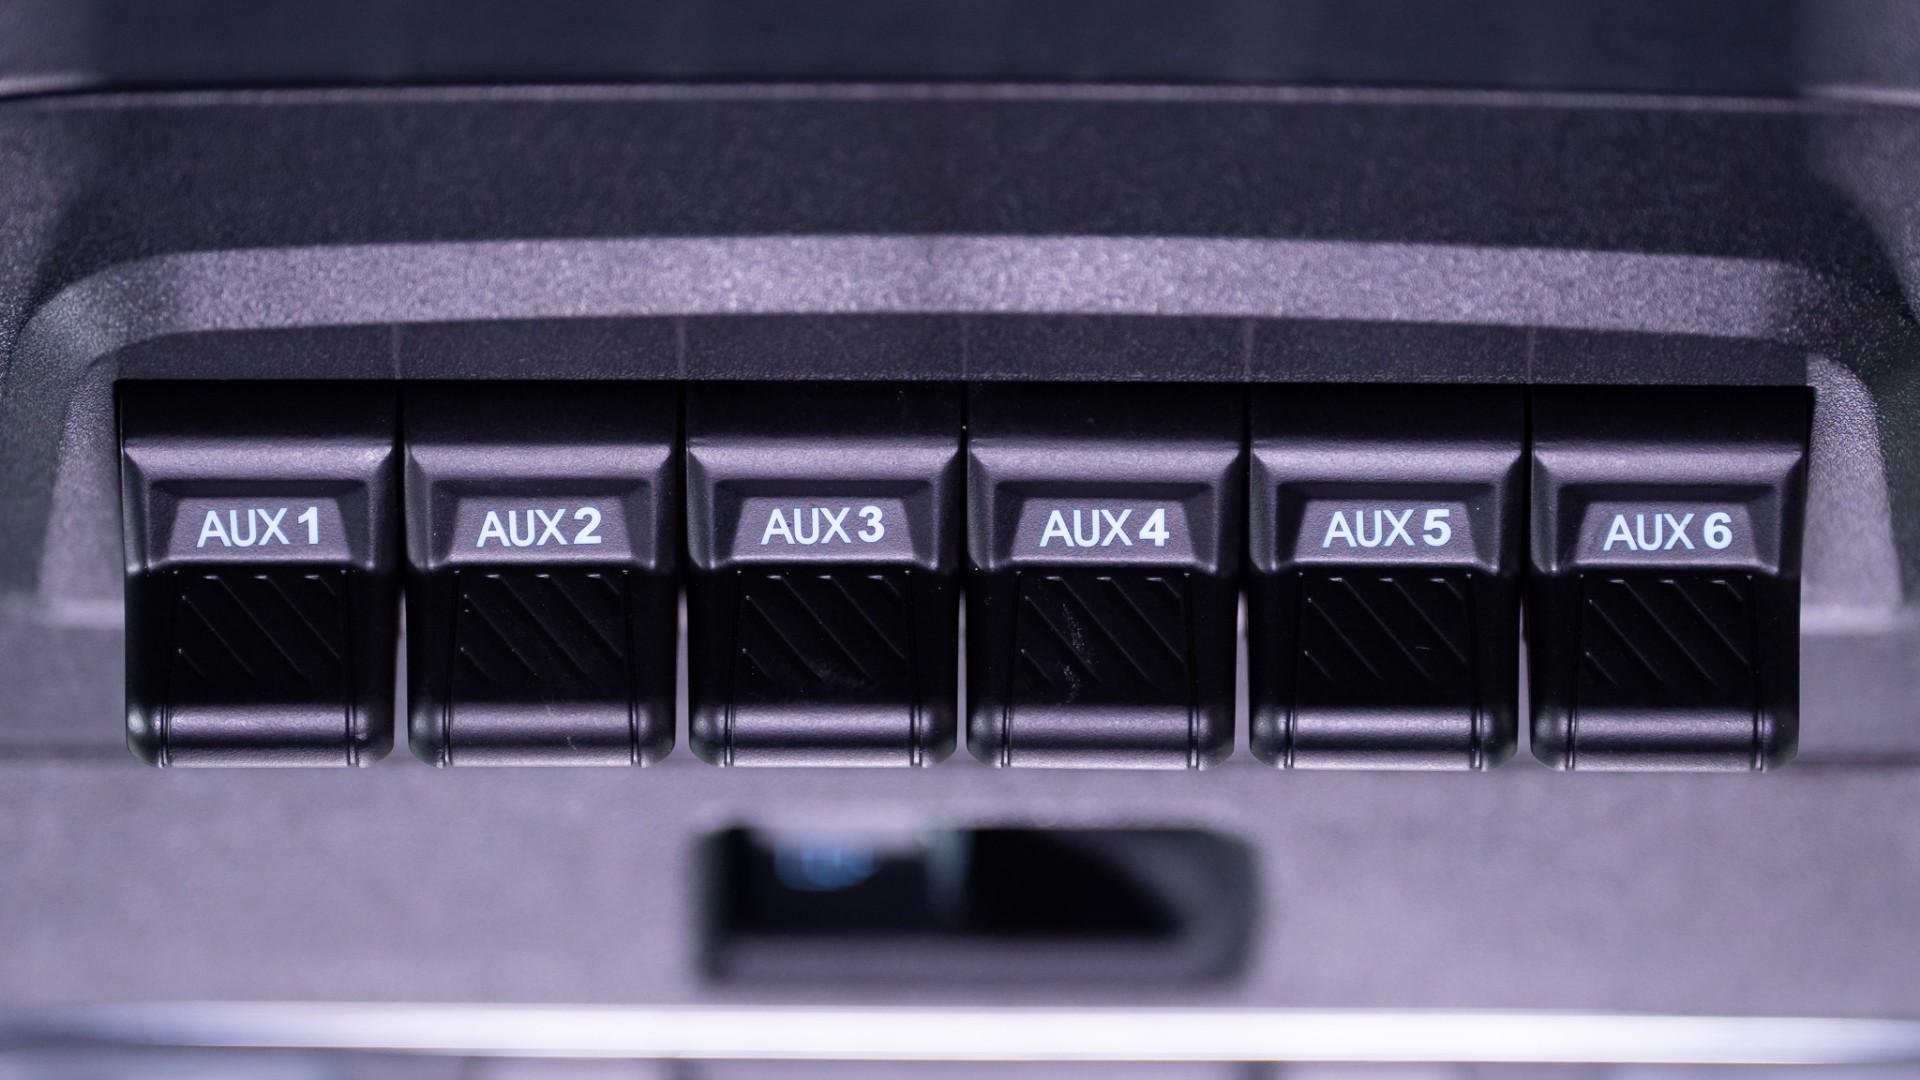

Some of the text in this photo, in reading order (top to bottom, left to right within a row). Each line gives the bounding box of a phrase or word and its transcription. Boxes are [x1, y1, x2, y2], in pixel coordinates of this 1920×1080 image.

[196, 506, 320, 548] AUX 1
[475, 506, 602, 548] AUX 2
[760, 503, 885, 545] AUX 3
[1039, 508, 1170, 548] AUX 4
[1322, 508, 1452, 548] AUX 5
[1602, 511, 1733, 551] AUX 6
